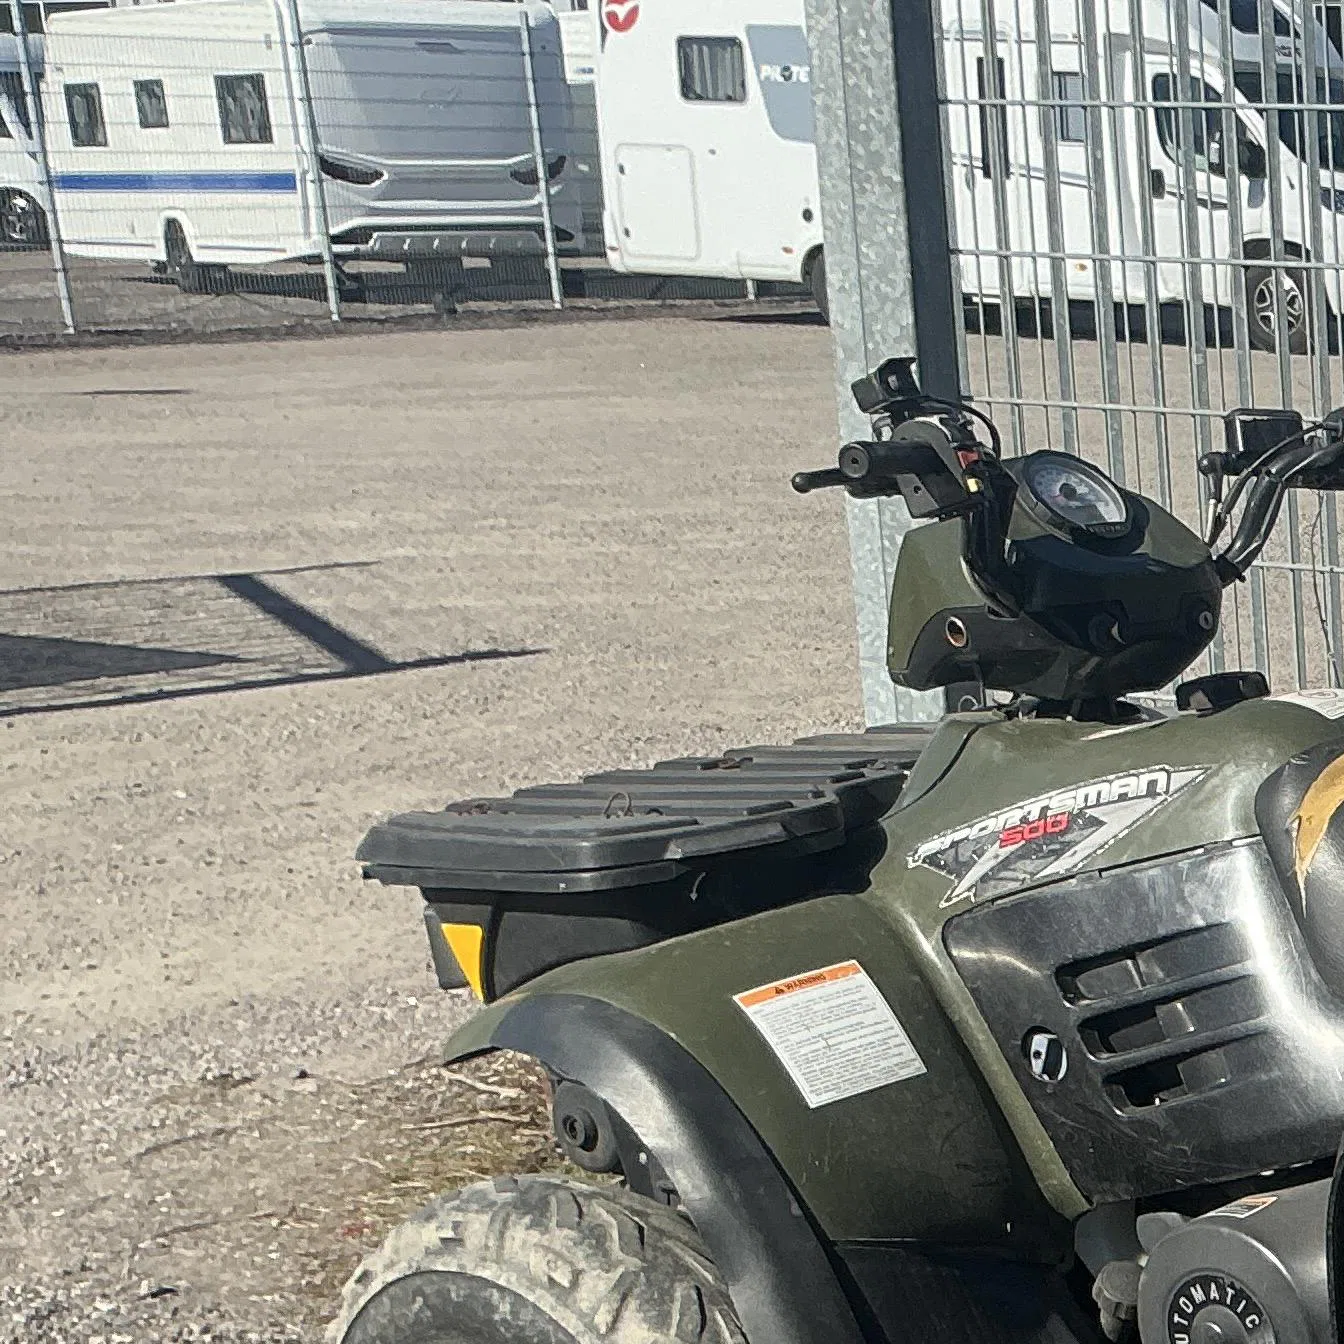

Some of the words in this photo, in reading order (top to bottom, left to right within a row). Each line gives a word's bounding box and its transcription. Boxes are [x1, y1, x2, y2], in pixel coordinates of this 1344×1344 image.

[917, 771, 1171, 857] SPORTSMAN
[999, 812, 1069, 849] 500
[785, 972, 827, 992] WARNING
